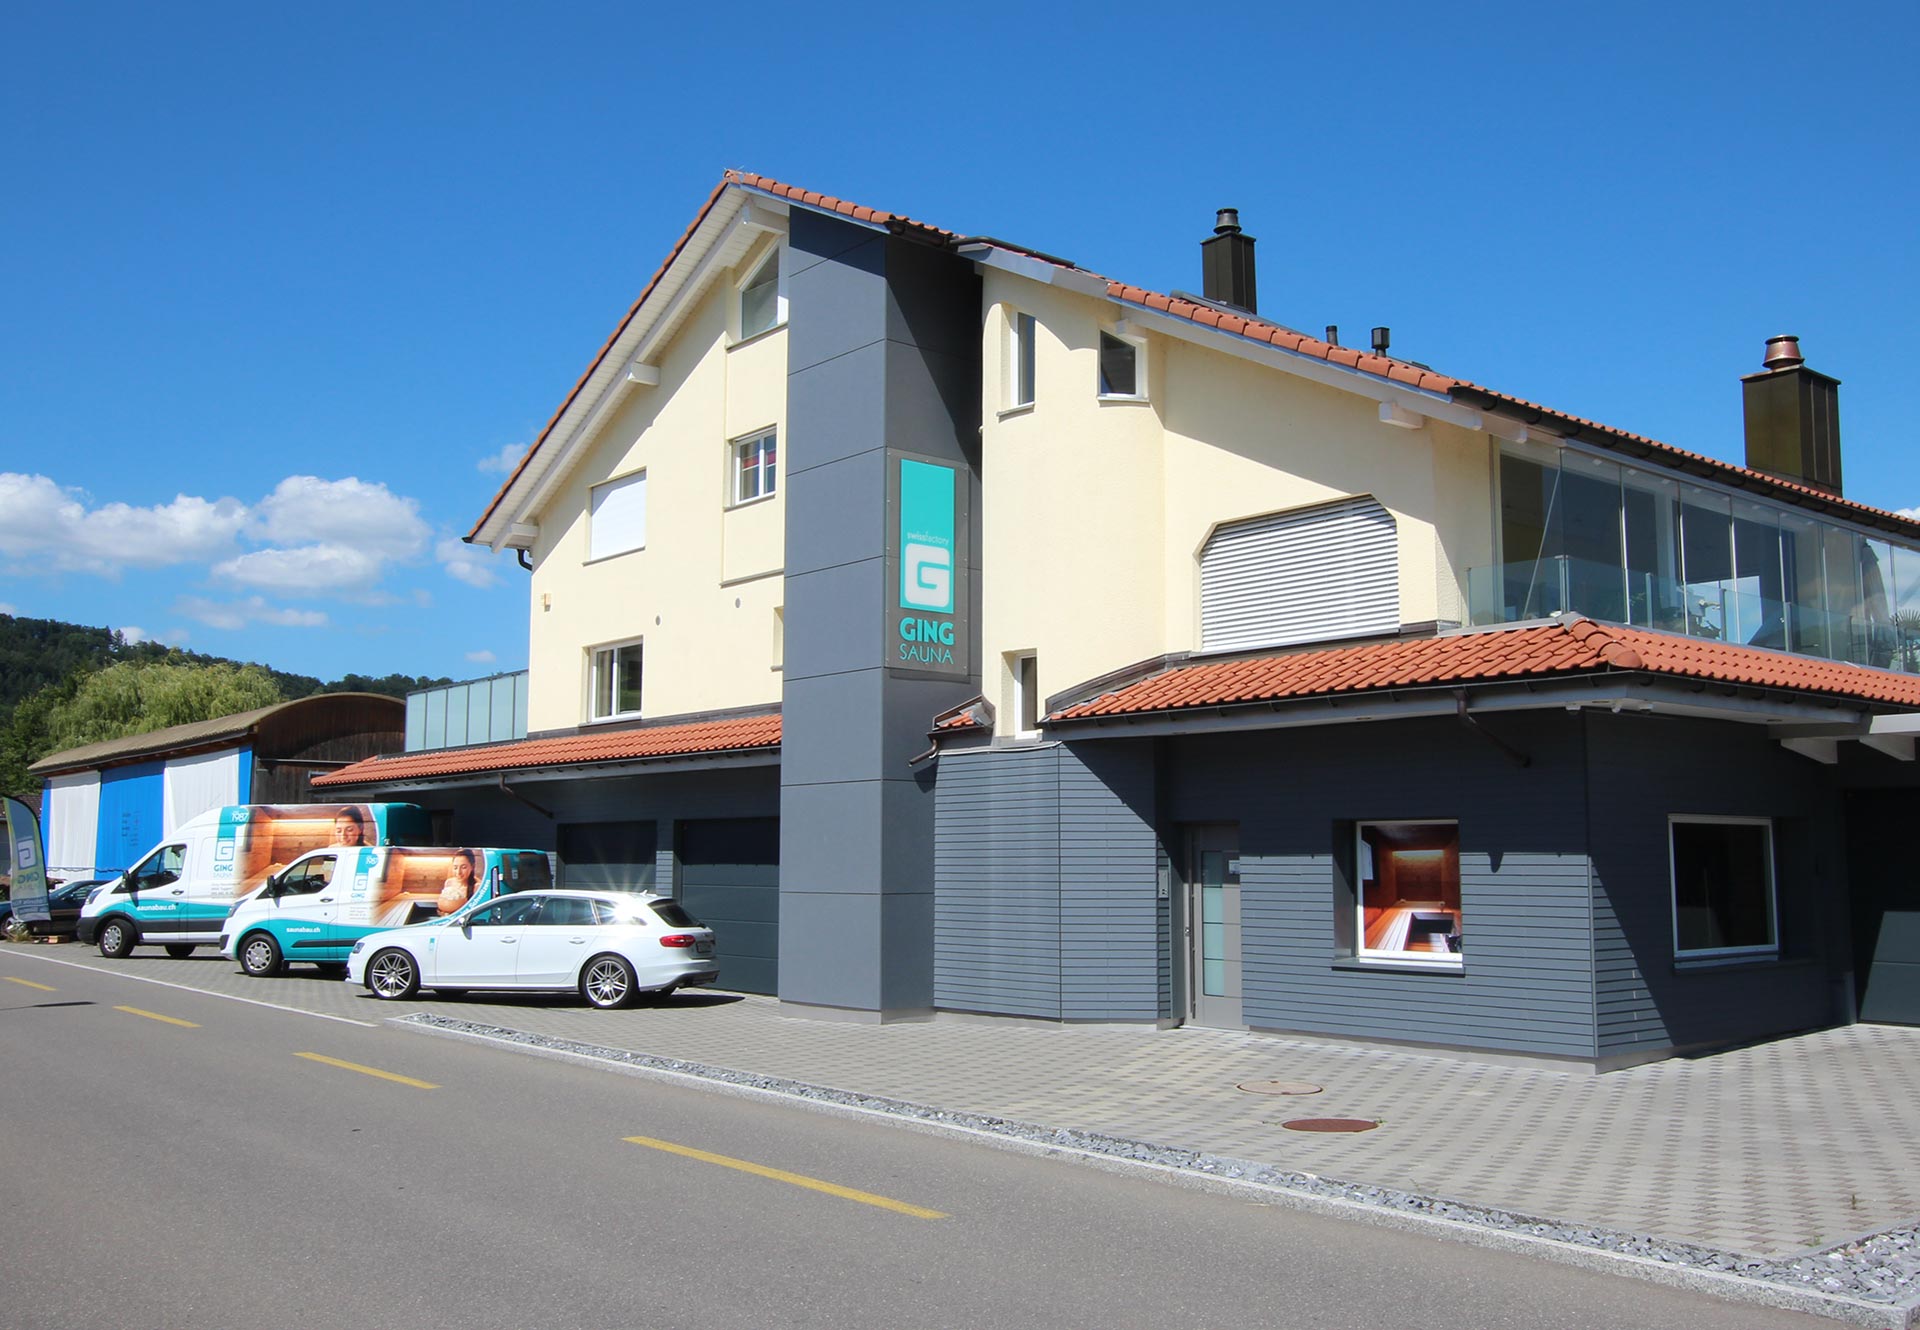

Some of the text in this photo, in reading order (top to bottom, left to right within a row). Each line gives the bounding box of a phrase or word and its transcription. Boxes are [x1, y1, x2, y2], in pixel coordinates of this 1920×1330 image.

[907, 530, 949, 546] swissfactory
[904, 542, 950, 607] G
[900, 617, 954, 645] GING
[900, 643, 954, 664] SAUNA
[231, 811, 249, 823] 1987
[213, 864, 233, 872] GING
